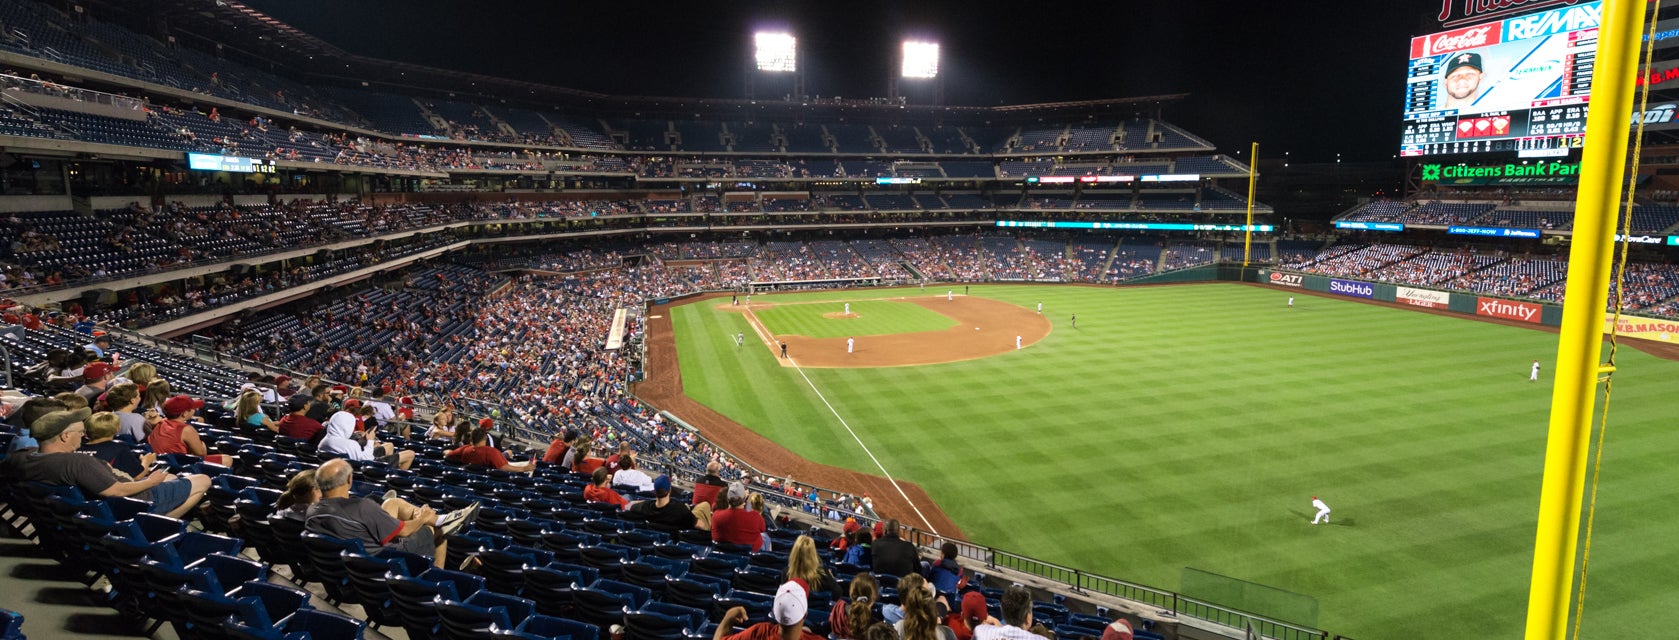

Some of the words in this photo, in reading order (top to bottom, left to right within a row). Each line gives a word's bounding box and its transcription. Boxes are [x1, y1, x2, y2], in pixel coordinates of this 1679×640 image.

[1508, 4, 1600, 41] RE/MAX
[1560, 137, 1567, 148] 1
[1572, 137, 1581, 148] 2
[1443, 165, 1502, 177] Citizens
[1504, 163, 1546, 177] Bank
[1281, 274, 1303, 284] ATI
[1330, 281, 1373, 296] StubHub
[1409, 298, 1433, 308] LAGER
[1480, 299, 1537, 321] xfinity
